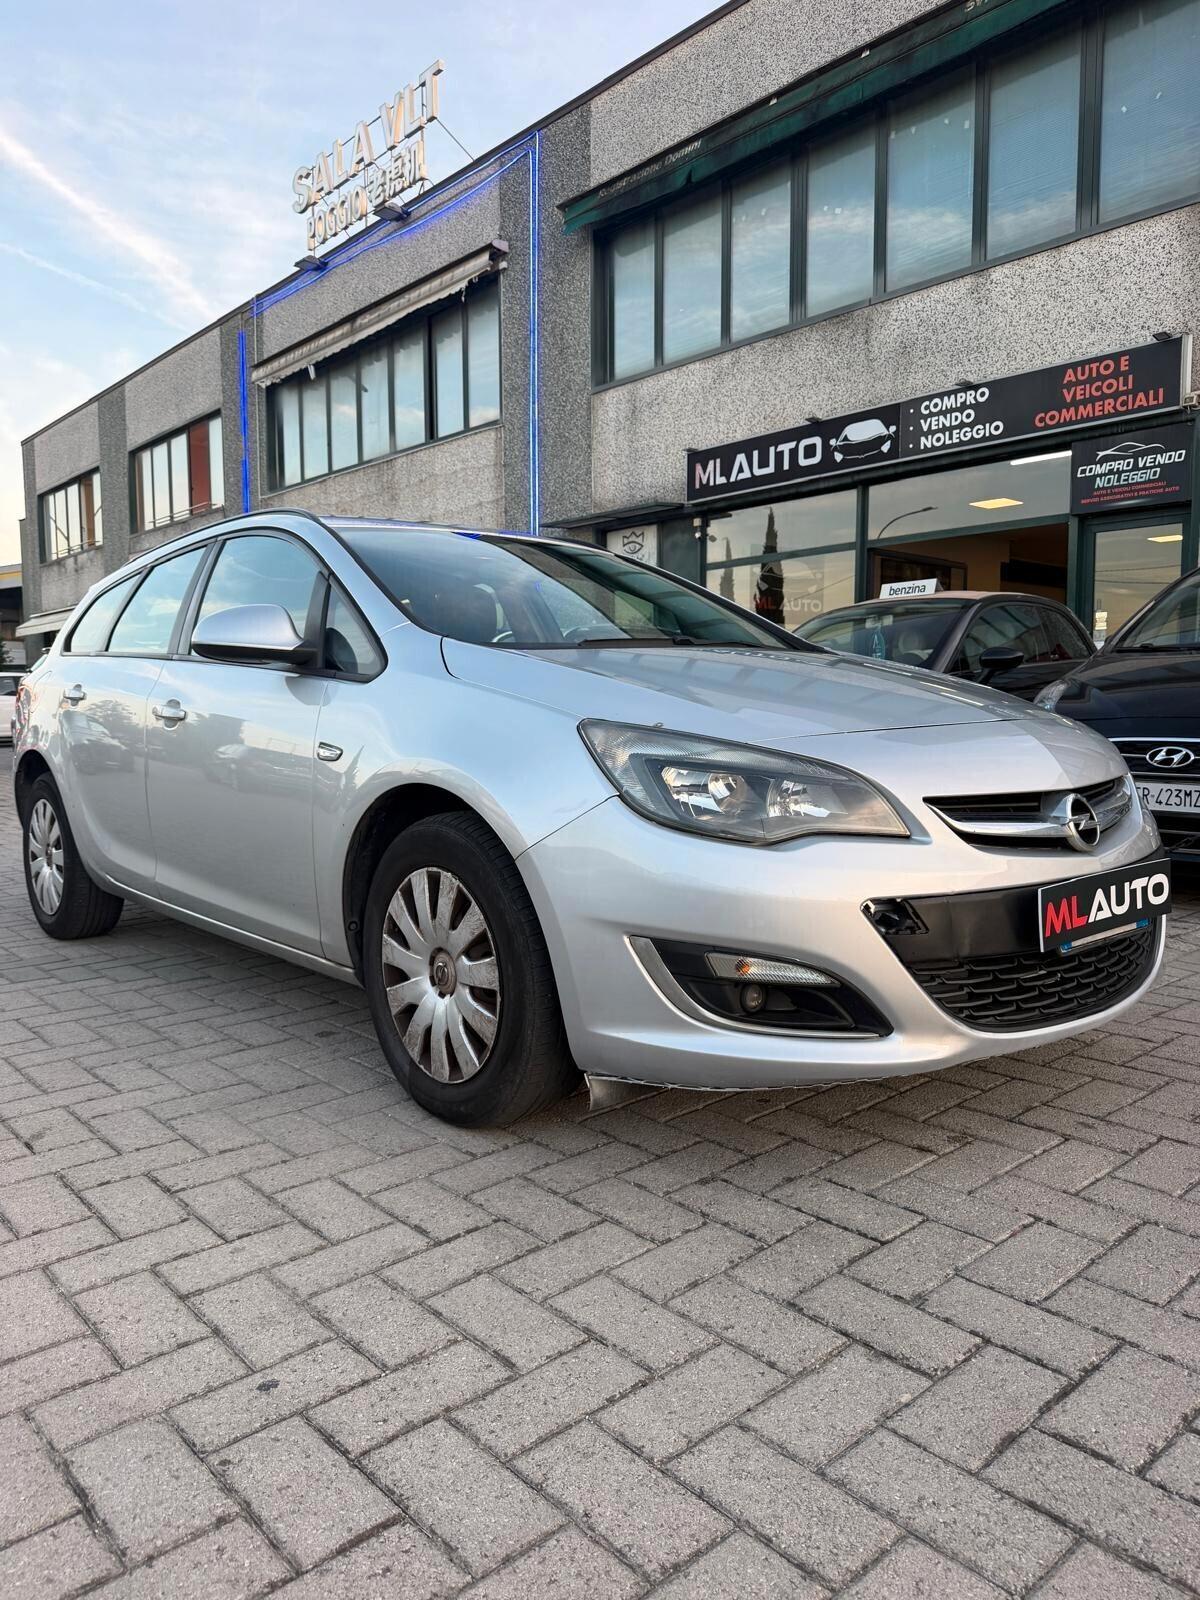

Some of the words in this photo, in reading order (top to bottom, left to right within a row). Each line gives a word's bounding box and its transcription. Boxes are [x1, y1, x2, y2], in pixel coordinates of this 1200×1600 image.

[292, 120, 374, 214] SALA
[379, 59, 445, 151] VLT
[307, 185, 368, 250] POGGIO
[1062, 359, 1115, 384] AUTO
[1120, 355, 1130, 371] E
[920, 387, 990, 415] COMPRO
[1062, 375, 1133, 403] VEICOLI
[920, 408, 975, 432] VENDO
[1034, 388, 1164, 428] COMMERCIALI
[920, 421, 1004, 450] NOLEGGIO
[1077, 458, 1134, 477] COMPRO
[1138, 450, 1186, 468] VENDO
[1095, 468, 1160, 488] NOLEGGIO
[888, 583, 927, 597] benzina
